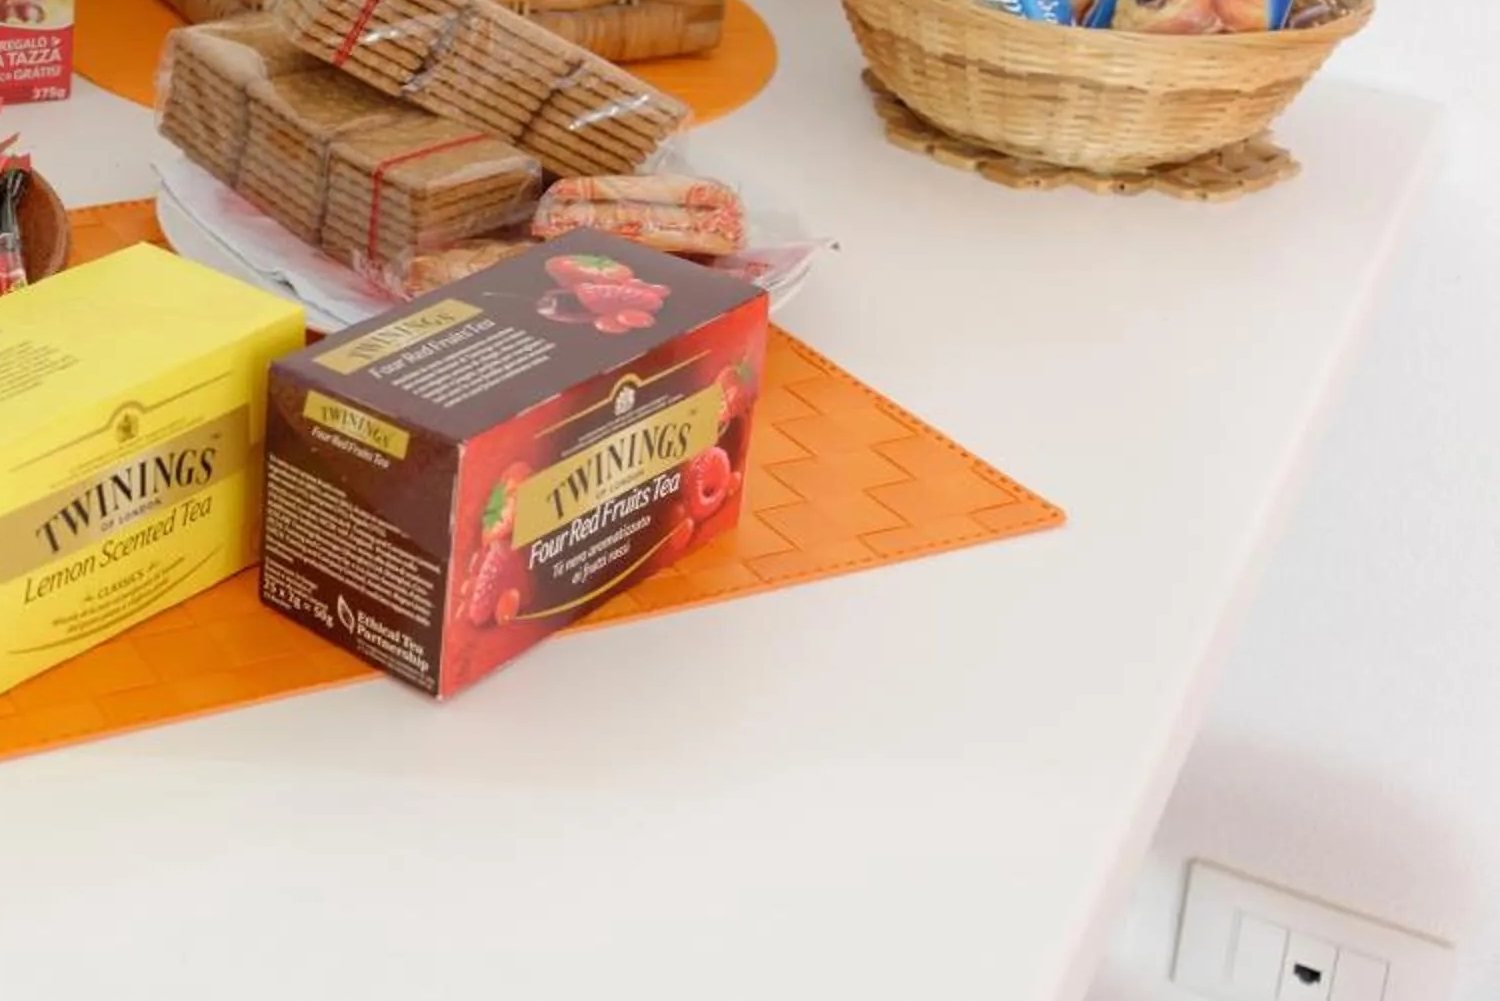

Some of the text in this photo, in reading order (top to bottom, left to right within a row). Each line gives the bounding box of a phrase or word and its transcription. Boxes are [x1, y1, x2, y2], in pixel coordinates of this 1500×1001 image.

[6, 48, 61, 67] TAZZA
[348, 312, 456, 361] TWININGS
[368, 355, 406, 380] Four
[404, 341, 433, 367] Red
[469, 316, 496, 338] Tea
[320, 405, 391, 449] TWININGS
[547, 422, 692, 520] TWININGS
[35, 447, 216, 554] TWININGS
[528, 530, 570, 570] Four
[568, 503, 601, 548] Red
[601, 485, 652, 527] Fruits
[652, 472, 682, 502] Tea
[24, 554, 96, 606] Lemon
[100, 508, 177, 568] Scented
[180, 496, 213, 527] Tea
[357, 610, 425, 656] Ethical Tea
[357, 624, 430, 673] Partnership
